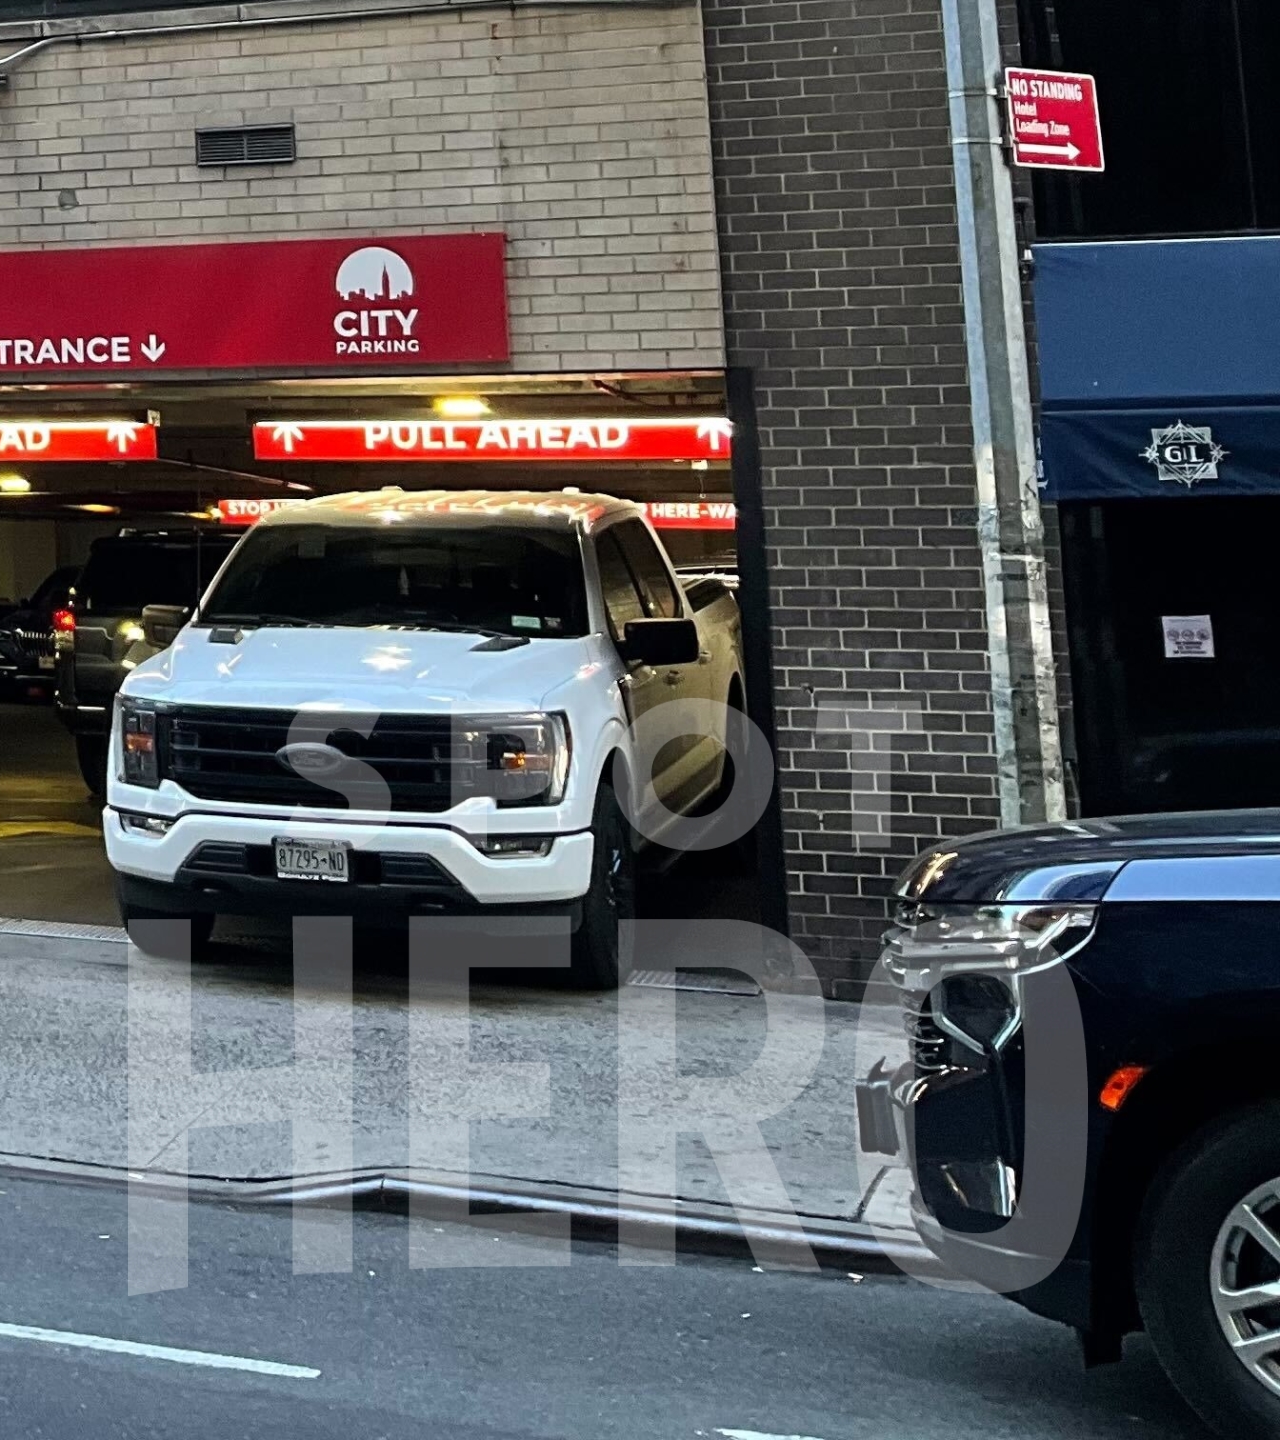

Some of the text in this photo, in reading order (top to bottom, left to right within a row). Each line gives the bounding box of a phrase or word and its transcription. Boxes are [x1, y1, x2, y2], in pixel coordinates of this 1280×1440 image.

[1011, 78, 1083, 101] NO STANDING
[1014, 101, 1037, 116] Hotel
[1015, 118, 1070, 138] Loading Zone
[333, 308, 420, 337] CITY
[335, 339, 420, 354] PARKING
[364, 421, 630, 450] PULL AHEAD
[228, 500, 271, 516] STOP
